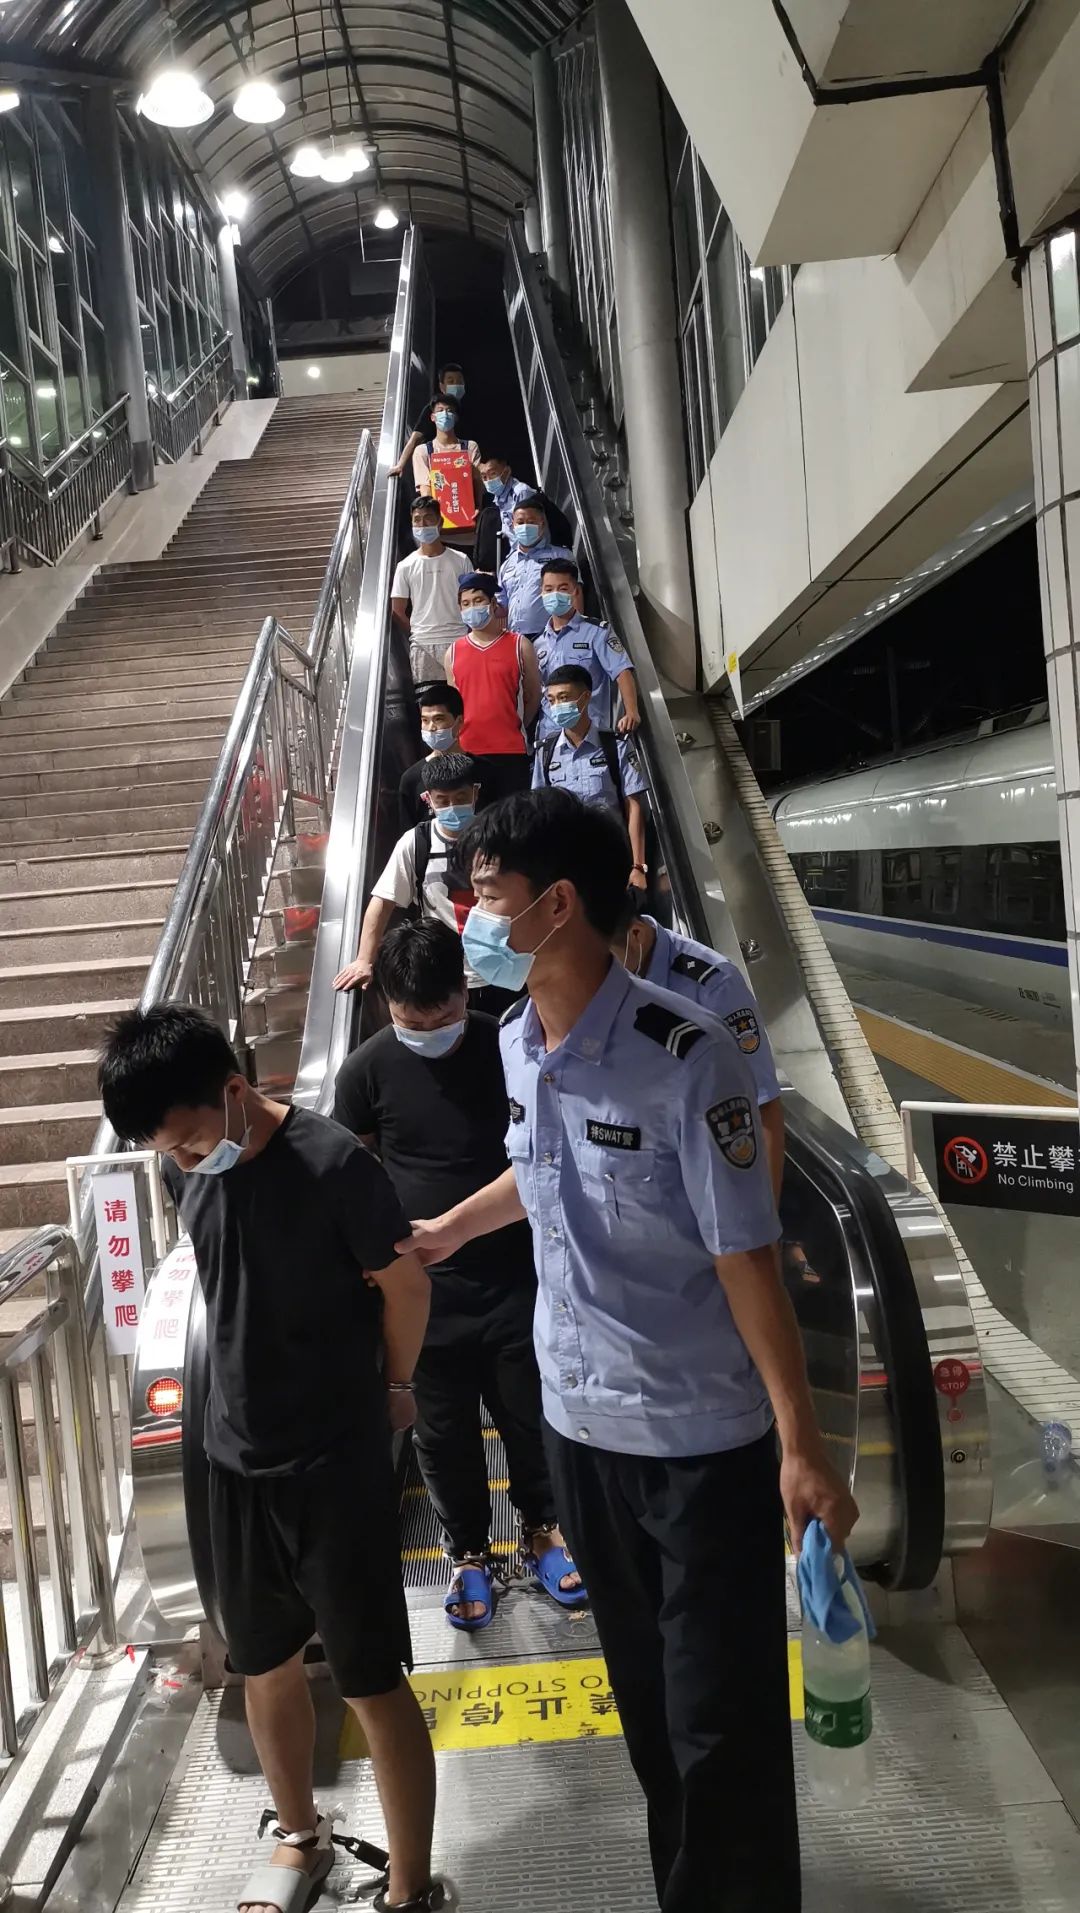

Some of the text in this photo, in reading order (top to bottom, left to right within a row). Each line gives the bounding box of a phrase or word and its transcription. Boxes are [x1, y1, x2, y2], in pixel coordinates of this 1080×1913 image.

[992, 1141, 1080, 1172] 禁止攀
[998, 1173, 1074, 1194] No Climbing
[104, 1199, 139, 1328] 请勿攀爬
[940, 1366, 963, 1378] 急停
[941, 1382, 965, 1390] STOP
